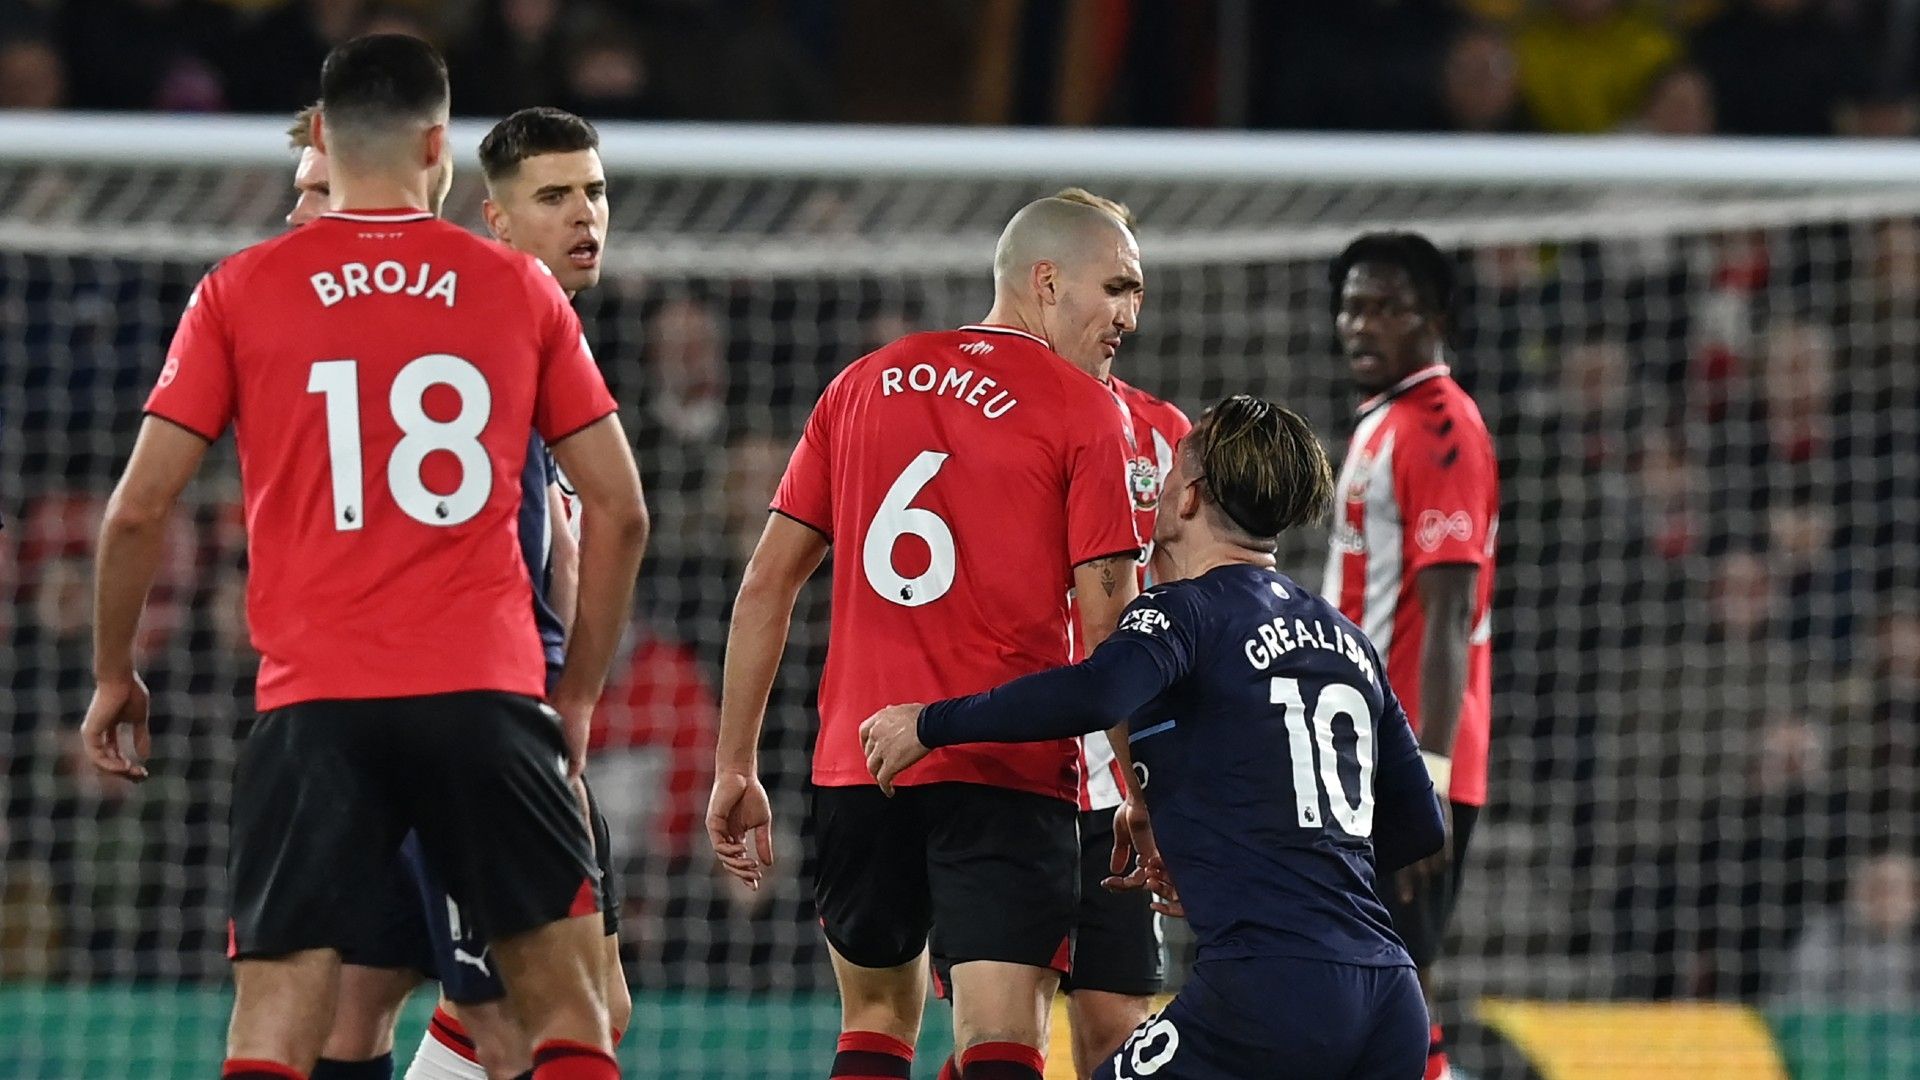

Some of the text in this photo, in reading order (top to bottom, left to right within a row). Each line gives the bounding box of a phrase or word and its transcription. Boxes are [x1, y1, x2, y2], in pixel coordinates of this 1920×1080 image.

[310, 260, 457, 307] BROJA
[306, 353, 492, 531] 18
[881, 363, 1017, 419] ROMEU
[862, 450, 956, 607] 6
[1244, 616, 1375, 684] GREALISH
[1269, 676, 1375, 839] 10
